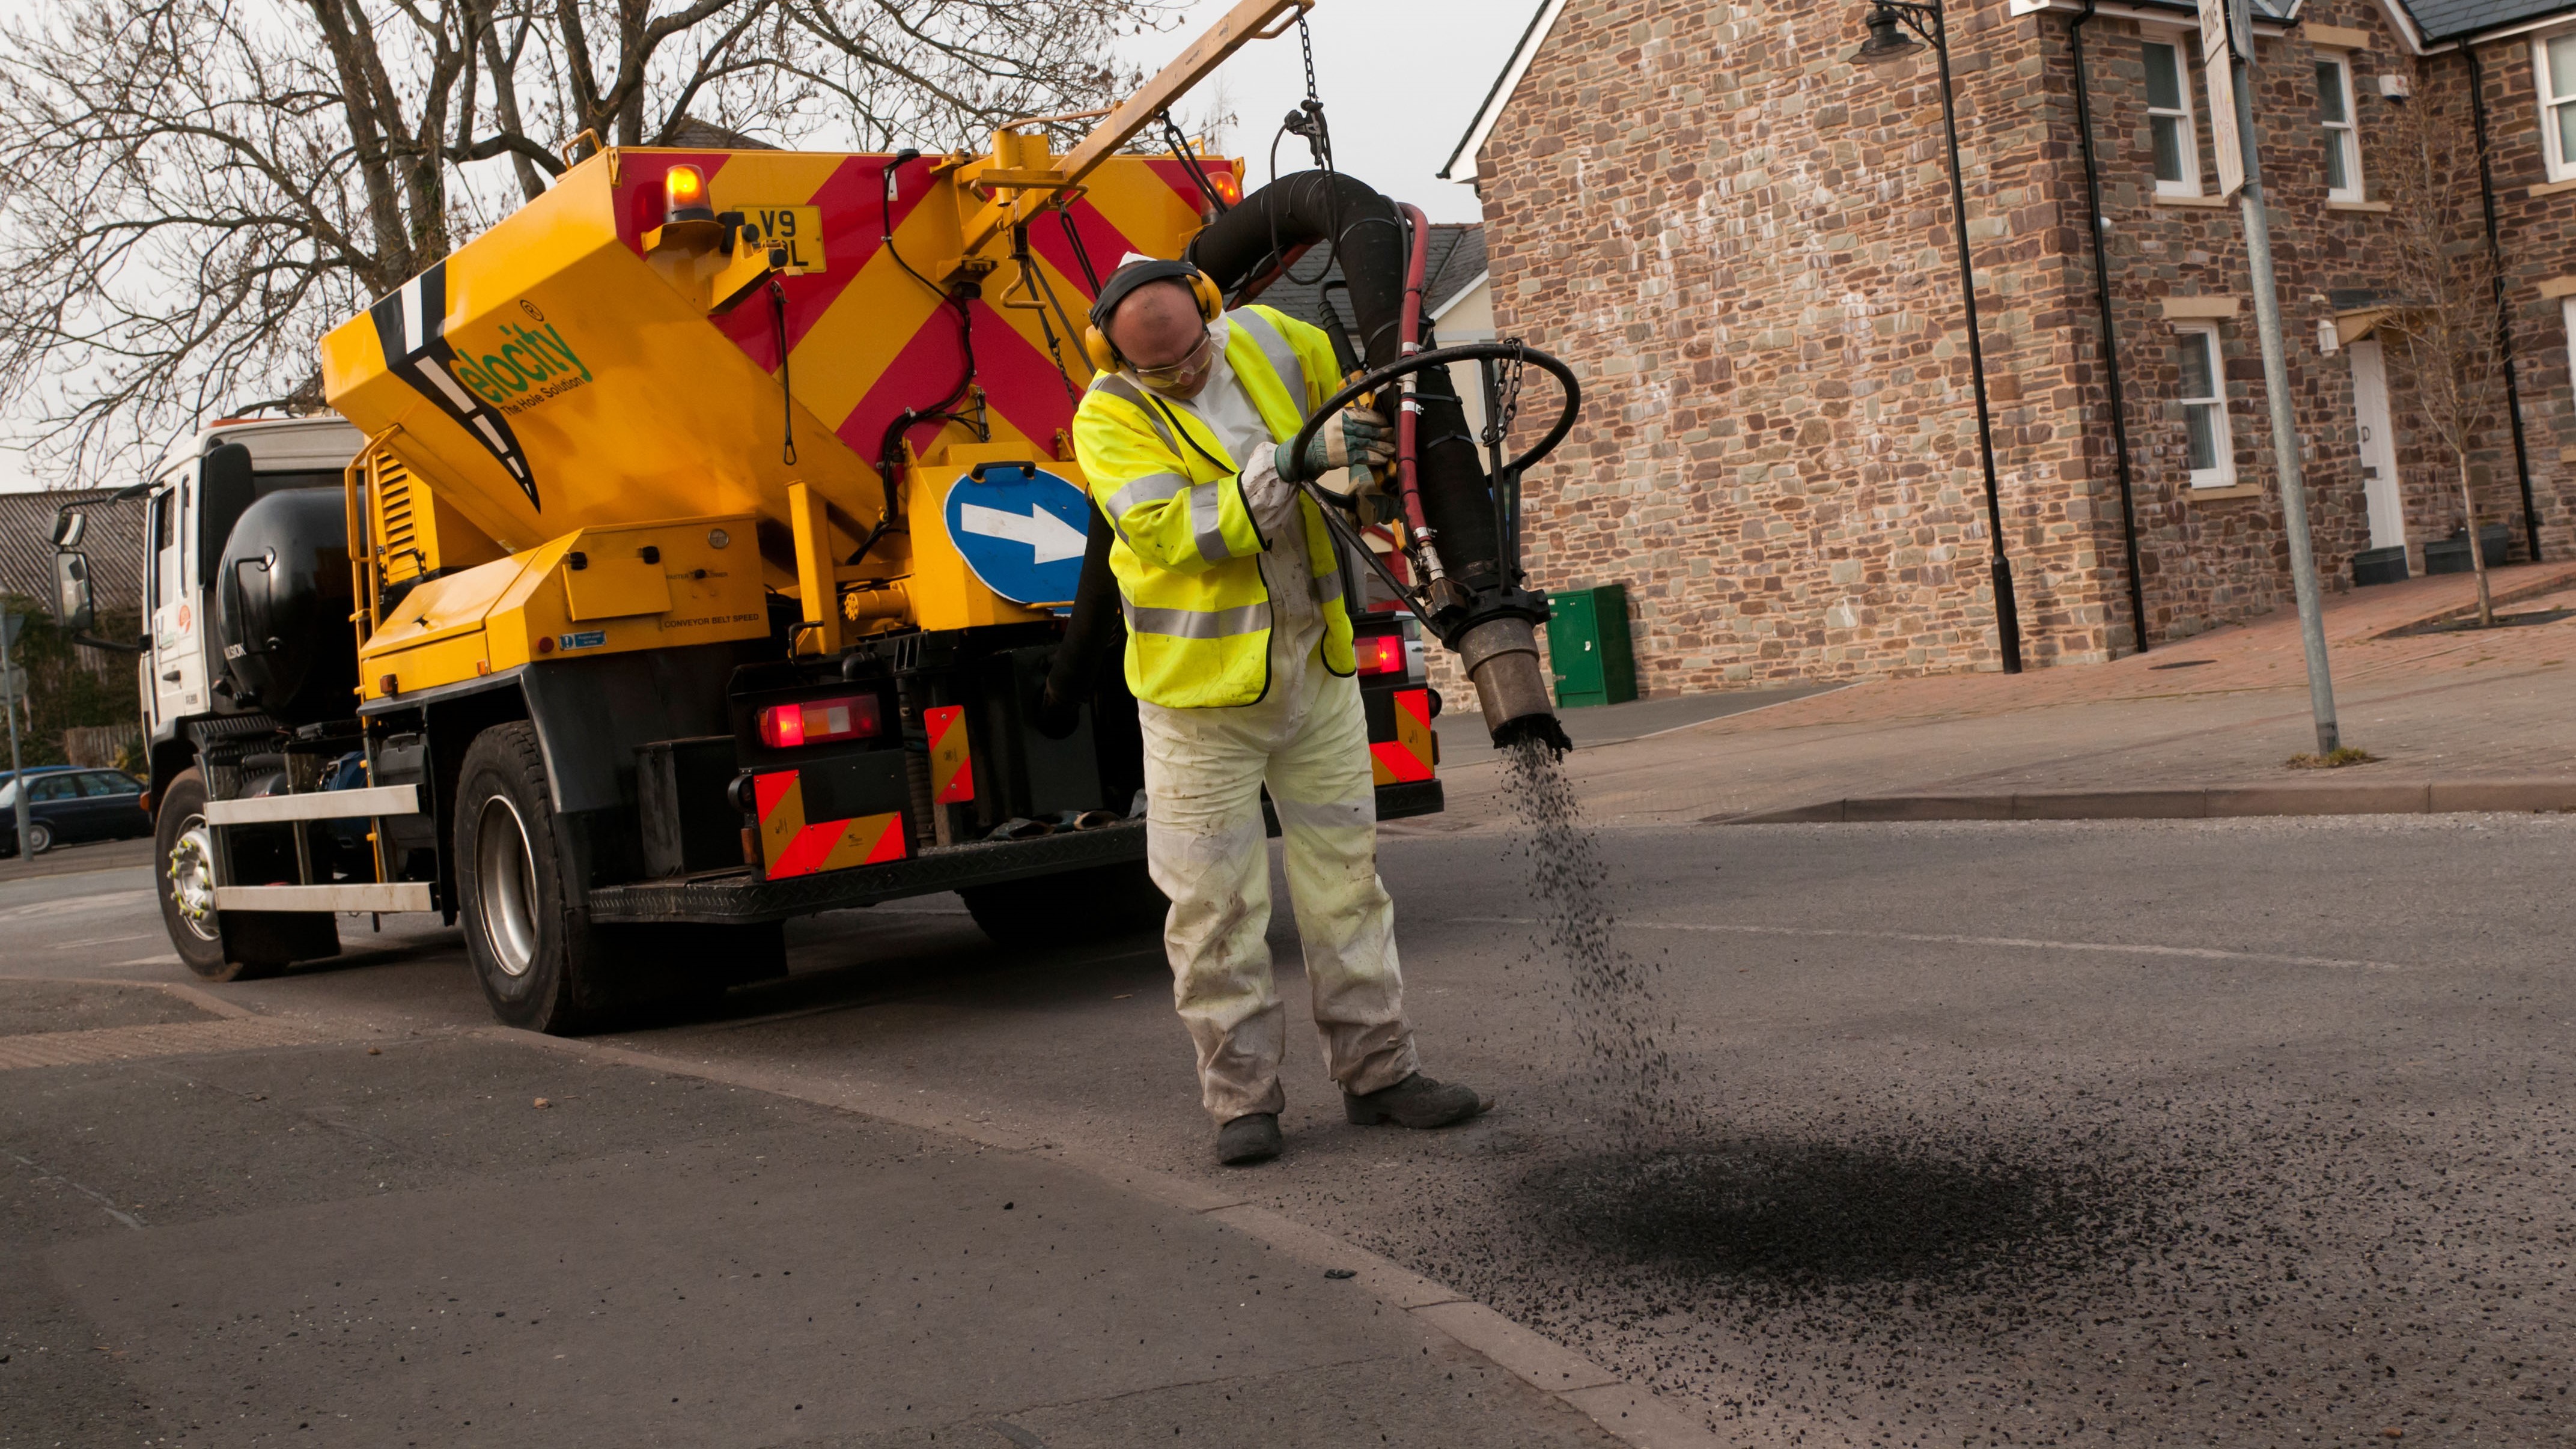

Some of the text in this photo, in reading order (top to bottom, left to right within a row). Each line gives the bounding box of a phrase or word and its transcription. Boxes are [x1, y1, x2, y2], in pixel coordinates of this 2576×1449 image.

[2202, 0, 2218, 44] ZONE
[760, 210, 796, 237] V9
[499, 376, 585, 416] The Hole Solution
[664, 613, 760, 628] CONVEYOR BELT SPEED
